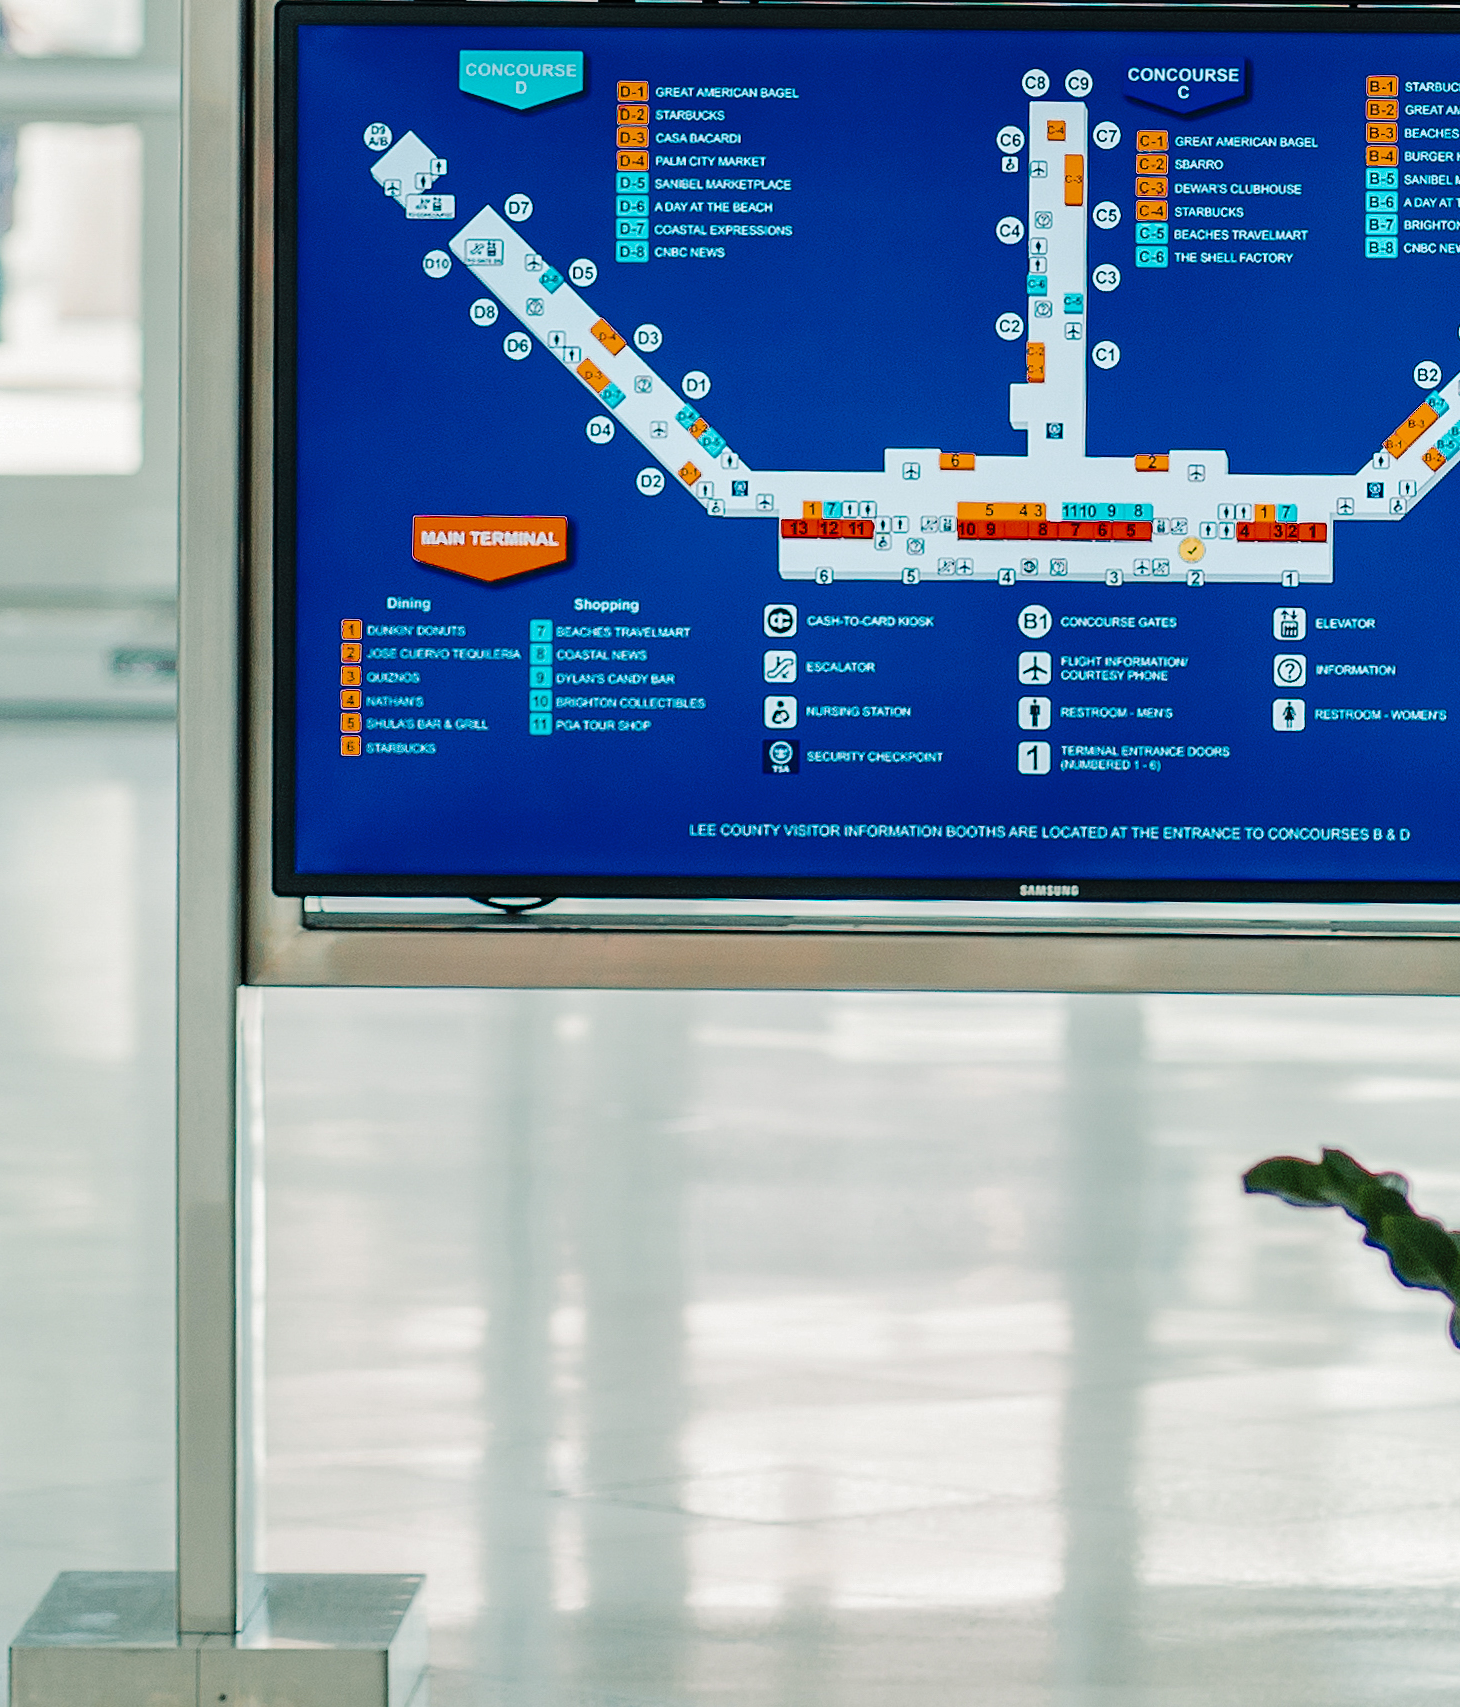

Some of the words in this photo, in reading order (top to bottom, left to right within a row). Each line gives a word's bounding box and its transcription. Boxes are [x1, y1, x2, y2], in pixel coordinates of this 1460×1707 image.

[465, 62, 577, 78] CONCOURSE
[1127, 67, 1239, 82] CONCOURSE
[1025, 76, 1045, 89] C8
[1068, 77, 1088, 90] C9
[1369, 80, 1395, 92] B-1
[619, 85, 645, 97] D-1
[655, 87, 693, 98] GREAT
[696, 87, 758, 99] AMERICAN
[760, 87, 799, 99] BAGEL
[619, 108, 645, 120] D-2
[656, 109, 725, 121] STARBUCKS
[1369, 103, 1395, 115] B-2
[1404, 104, 1444, 116] GREAT
[619, 131, 645, 143] D-3
[655, 133, 688, 144] CASA
[689, 132, 742, 144] BACARDI
[1096, 130, 1117, 142] C7
[1369, 127, 1395, 139] B-3
[1404, 128, 1460, 139] BEACHES
[1000, 134, 1021, 147] C6
[1139, 135, 1165, 147] C-1
[1175, 136, 1213, 147] GREAT
[1216, 136, 1277, 148] AMERICAN
[1280, 137, 1318, 148] BAGEL
[619, 154, 645, 166] D-4
[655, 156, 687, 166] PALM
[689, 155, 715, 167] CITY
[718, 156, 765, 167] MARKET
[1369, 150, 1395, 162] B-4
[1404, 150, 1454, 163] BURGER
[1139, 158, 1165, 170] C-2
[1175, 159, 1224, 170] SBARRO
[1369, 173, 1395, 185] B-5
[1404, 174, 1451, 186] SANIBEL
[1139, 182, 1165, 194] C-3
[1230, 183, 1301, 195] CLUBHOUSE
[509, 201, 529, 214] D7
[1369, 196, 1395, 208] B-6
[1414, 198, 1437, 208] DAY
[1096, 209, 1117, 222] C5
[1139, 205, 1165, 217] C-4
[1174, 206, 1244, 218] STARBUCKS
[1000, 224, 1020, 237] C4
[1369, 219, 1395, 231] B-7
[1139, 228, 1165, 240] C-5
[1173, 229, 1229, 241] BEACHES
[1232, 229, 1308, 241] TRAVELMART
[619, 246, 645, 258] D-8
[1369, 242, 1395, 254] B-8
[1403, 242, 1437, 255] CNBC
[426, 258, 448, 269] D10
[1139, 251, 1165, 263] C-6
[1174, 252, 1197, 263] THE
[1200, 252, 1236, 263] SHELL
[1239, 252, 1293, 264] FACTORY
[573, 266, 593, 280] D5
[1096, 271, 1116, 284] C3
[474, 306, 495, 319] D8
[1000, 320, 1020, 332] C2
[639, 331, 658, 345] D3
[508, 339, 528, 352] D6
[1096, 348, 1114, 361] C1
[1418, 368, 1438, 382] B2
[687, 378, 705, 392] D1
[591, 424, 610, 436] D4
[642, 475, 661, 488] D2
[420, 530, 465, 546] MAIN
[469, 530, 560, 547] TERMINAL
[387, 597, 431, 612] Dining
[574, 598, 640, 614] Shopping
[1060, 616, 1136, 628] CONCOURSE
[1137, 617, 1177, 628] GATES
[1315, 617, 1376, 630] ELEVATOR
[1316, 664, 1397, 676] INFORMATION
[1019, 884, 1080, 897] SAMSUNG
